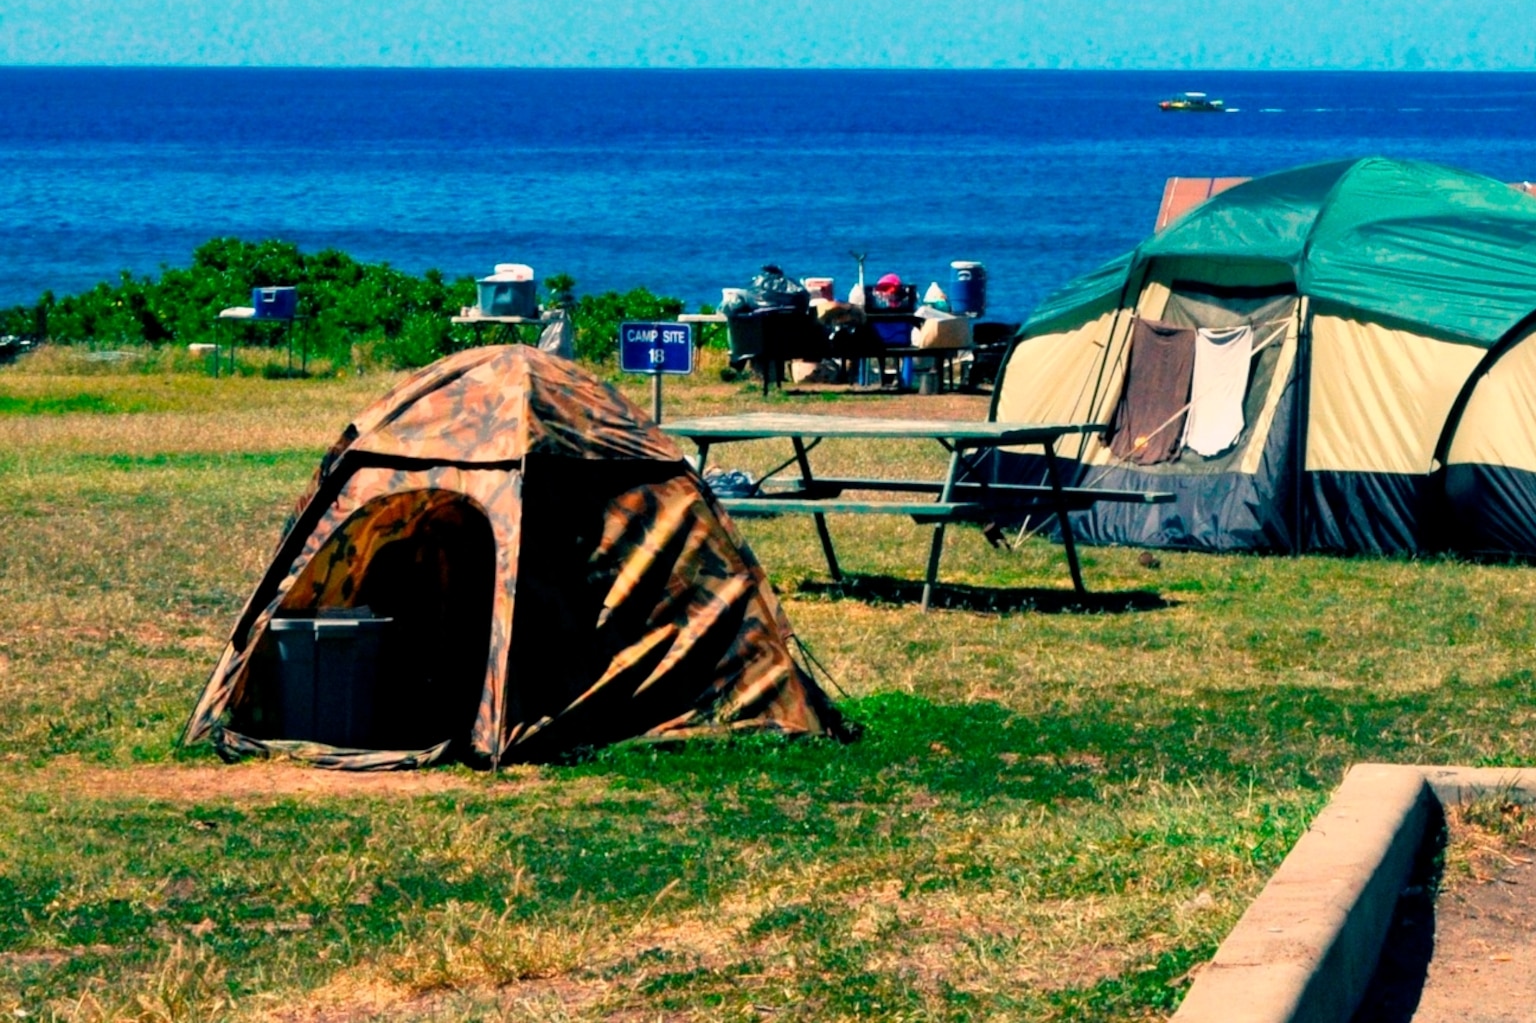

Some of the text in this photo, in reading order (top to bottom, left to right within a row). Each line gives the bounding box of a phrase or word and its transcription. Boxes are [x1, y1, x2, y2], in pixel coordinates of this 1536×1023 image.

[627, 329, 685, 343] CAMP SITE
[648, 348, 665, 363] 18
